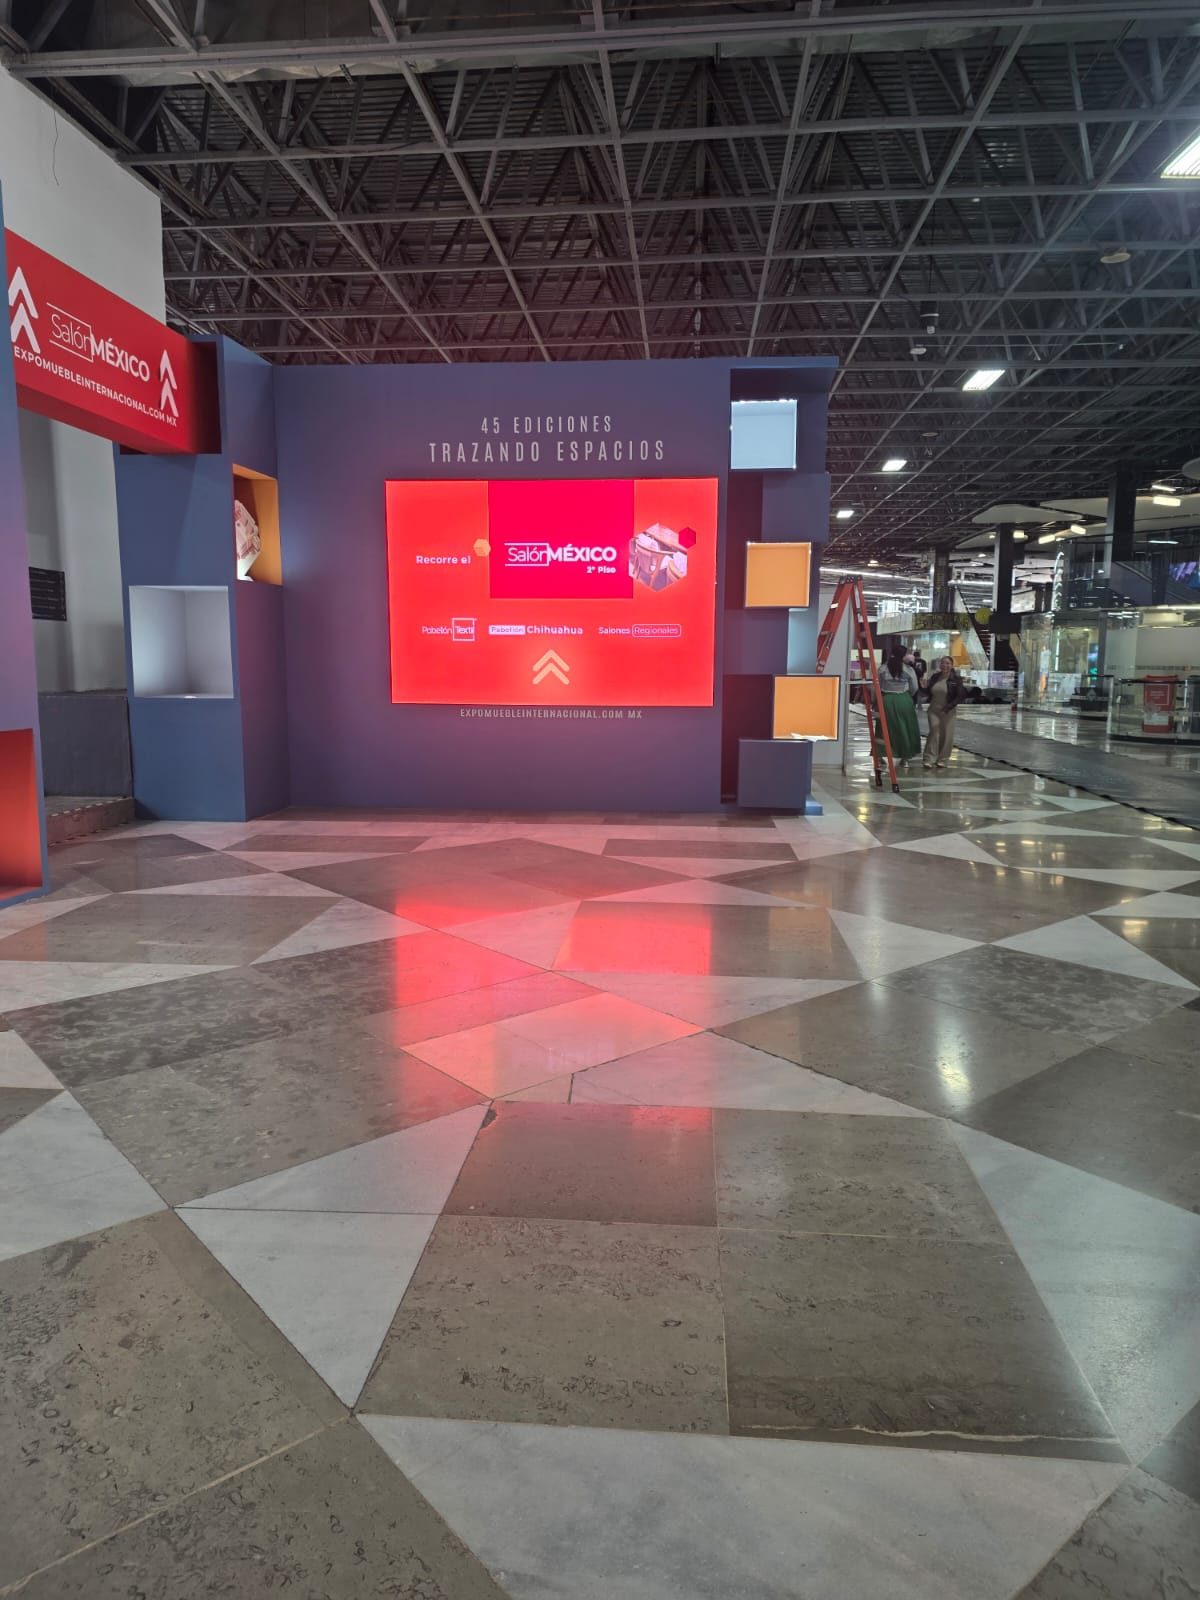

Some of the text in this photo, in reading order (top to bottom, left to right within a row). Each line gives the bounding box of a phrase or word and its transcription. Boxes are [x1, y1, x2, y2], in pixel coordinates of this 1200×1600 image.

[481, 415, 613, 434] 45 EDICIONES
[429, 440, 665, 463] TRAZANDO ESPACIOS
[416, 555, 471, 565] Recorre el
[597, 566, 616, 574] Piso
[526, 625, 583, 635] Chihuahua
[598, 626, 679, 636] Salones Regionales
